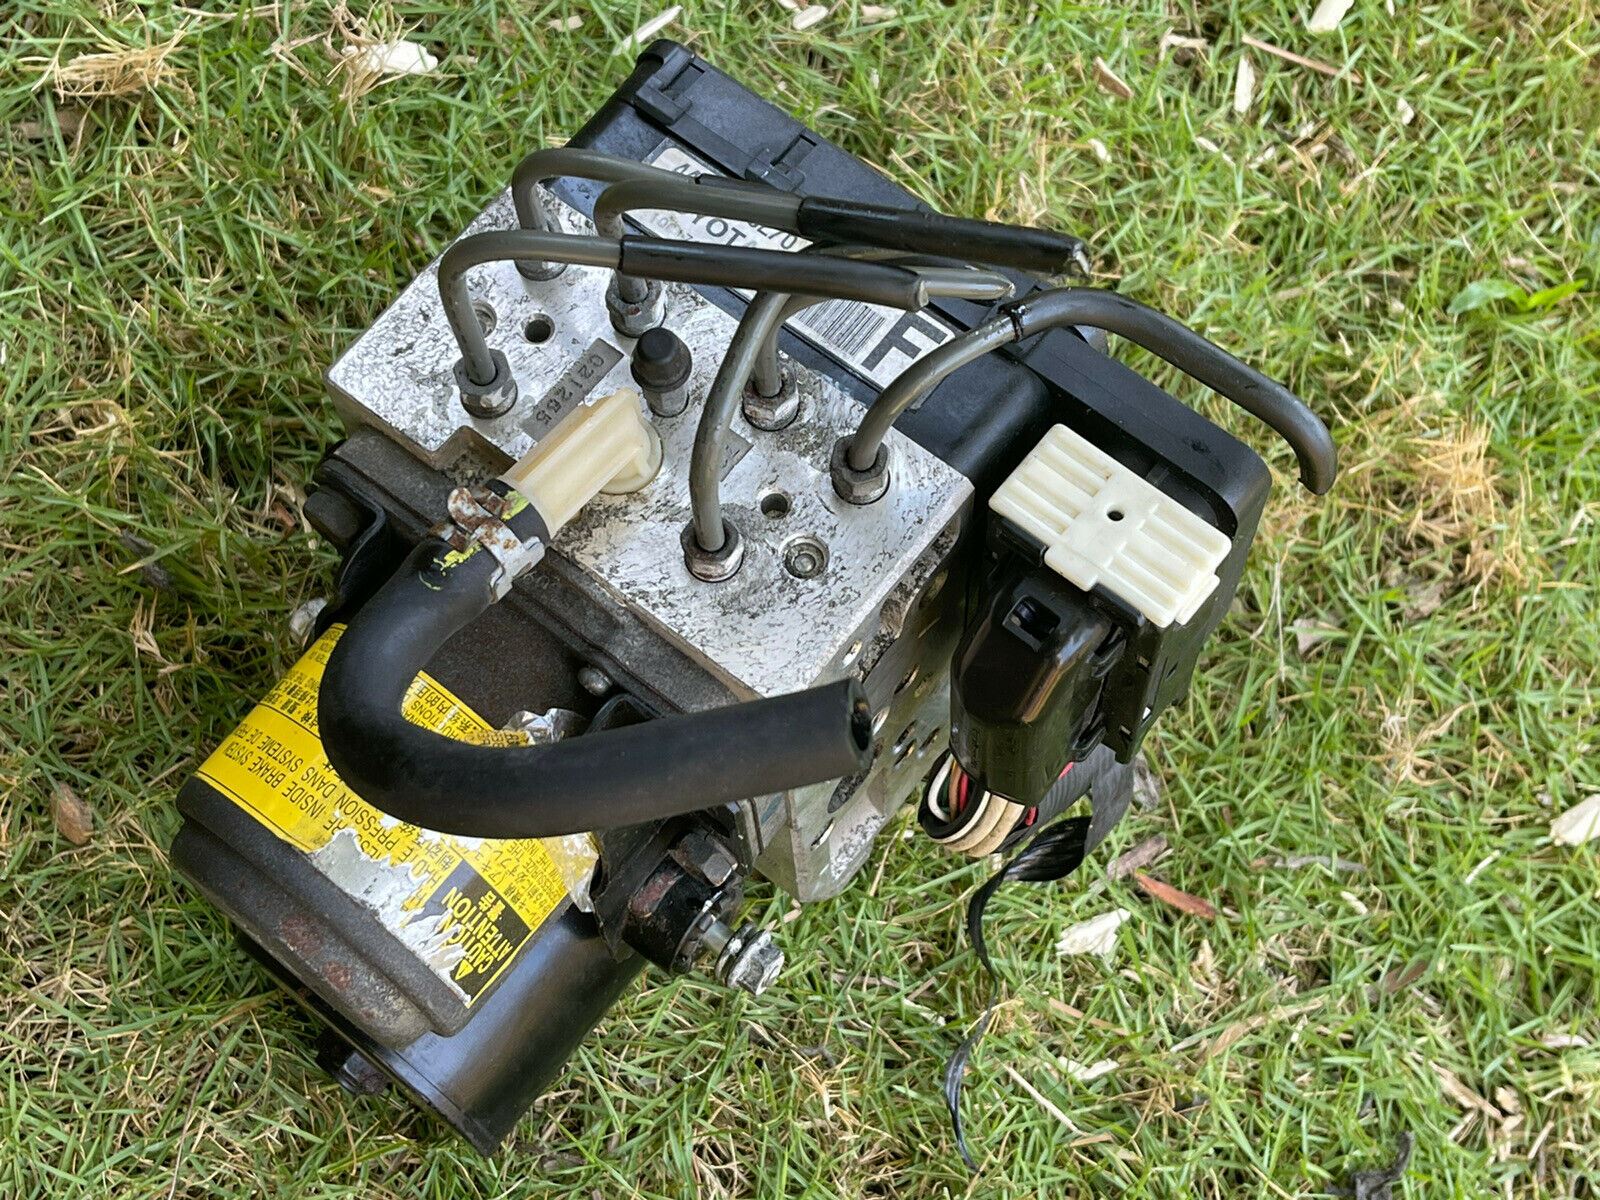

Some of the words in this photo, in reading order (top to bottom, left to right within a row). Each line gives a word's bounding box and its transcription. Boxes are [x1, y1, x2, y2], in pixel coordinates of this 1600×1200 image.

[247, 755, 285, 788] BRAKE
[299, 764, 336, 799] DANS
[282, 780, 326, 820] INSIDE
[333, 792, 400, 851] PRESSION
[505, 841, 525, 862] THE
[440, 885, 512, 961] ATTENTION
